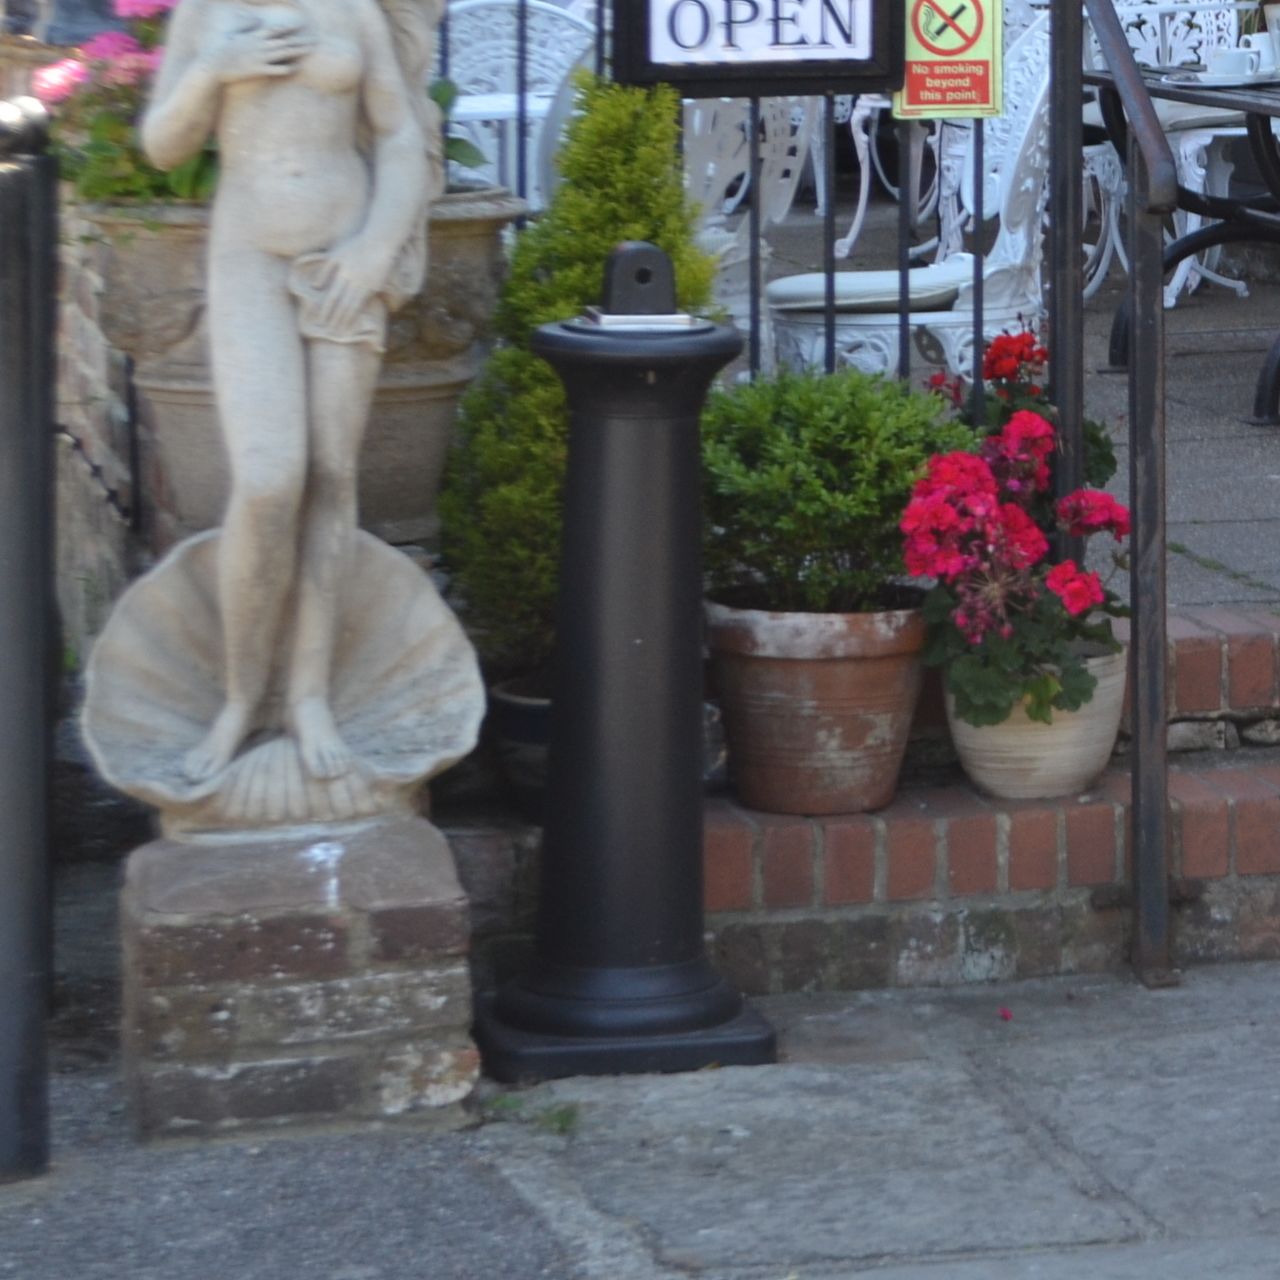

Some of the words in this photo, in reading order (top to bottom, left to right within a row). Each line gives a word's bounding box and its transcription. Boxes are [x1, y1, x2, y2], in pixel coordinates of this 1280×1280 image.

[911, 63, 929, 74] No
[933, 63, 984, 76] smoking
[925, 77, 971, 88] beyond
[919, 90, 942, 100] this
[946, 90, 977, 101] point
